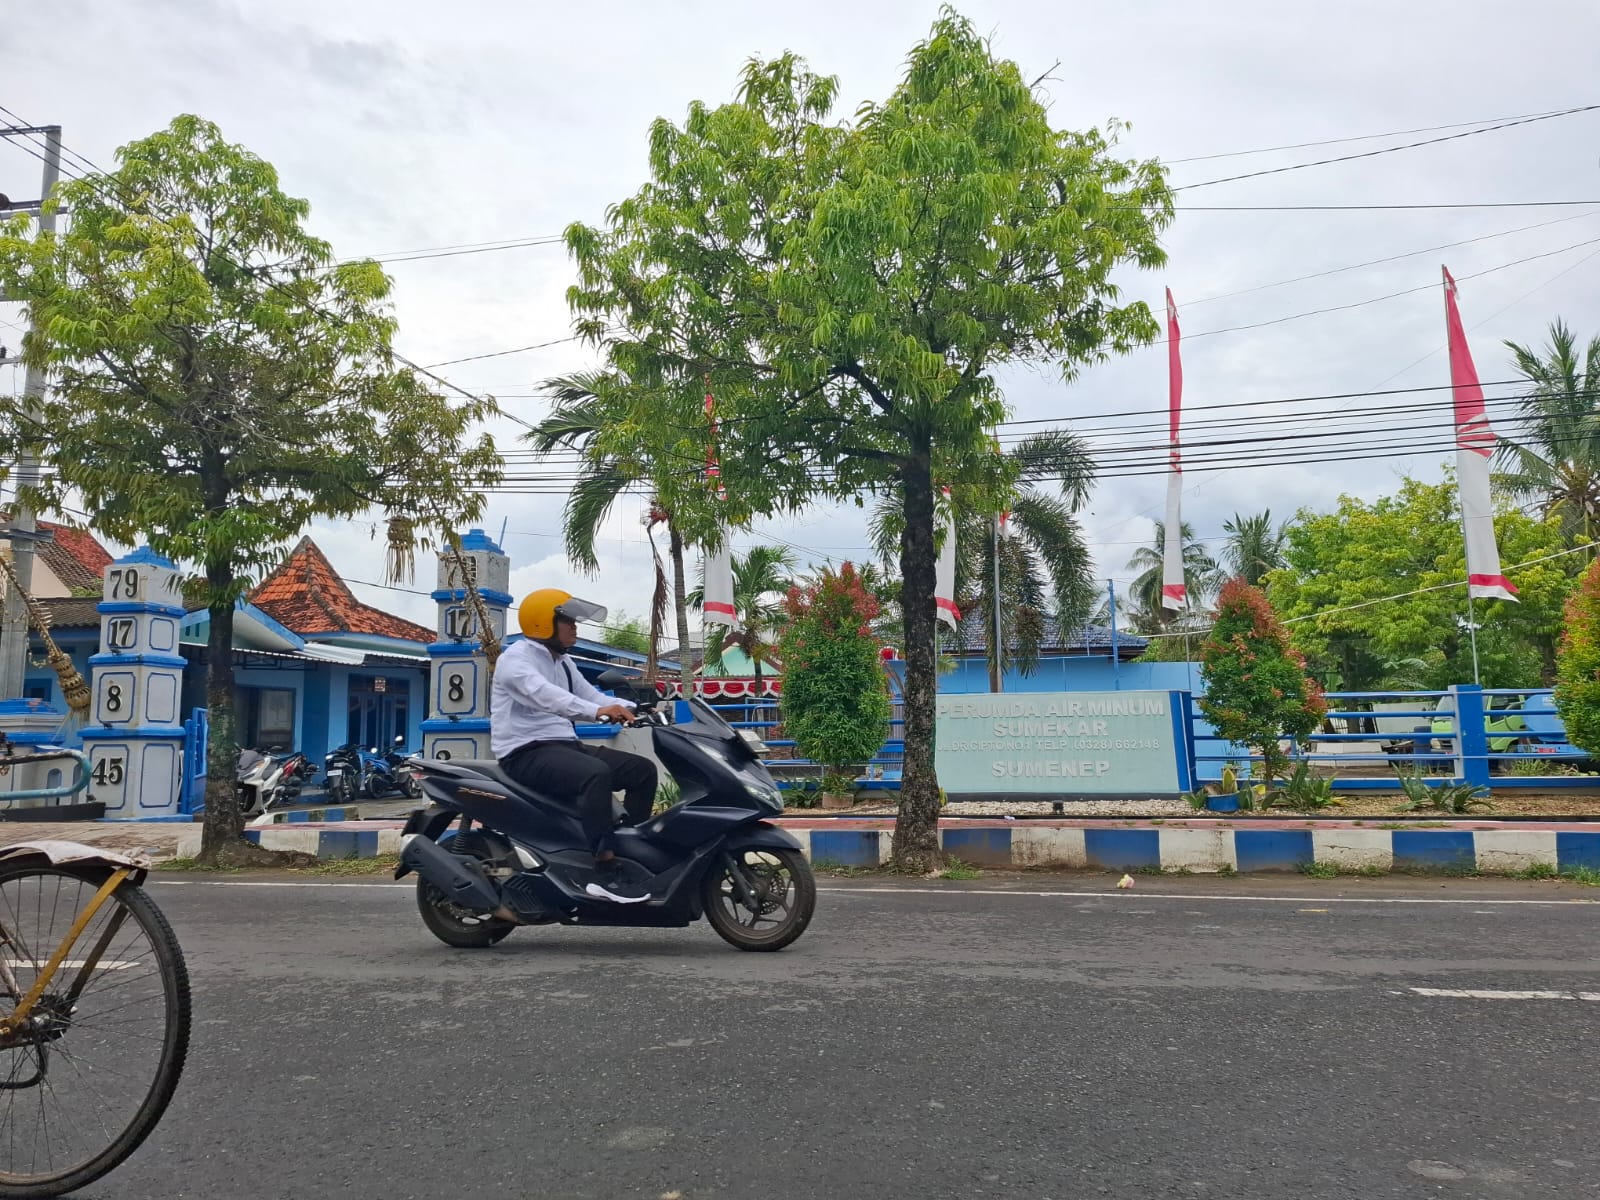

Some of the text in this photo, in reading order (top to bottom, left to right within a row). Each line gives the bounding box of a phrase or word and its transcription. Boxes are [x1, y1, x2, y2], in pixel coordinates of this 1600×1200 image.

[110, 568, 138, 599] 79
[109, 619, 133, 647] 17
[447, 609, 469, 638] 17
[106, 685, 122, 712] 8
[448, 674, 464, 702] 8
[936, 698, 1165, 719] PERUMDA AIR MINUM
[993, 719, 1109, 738] SUMEKAR
[92, 757, 123, 786] 45
[991, 759, 1111, 778] SUMENEP
